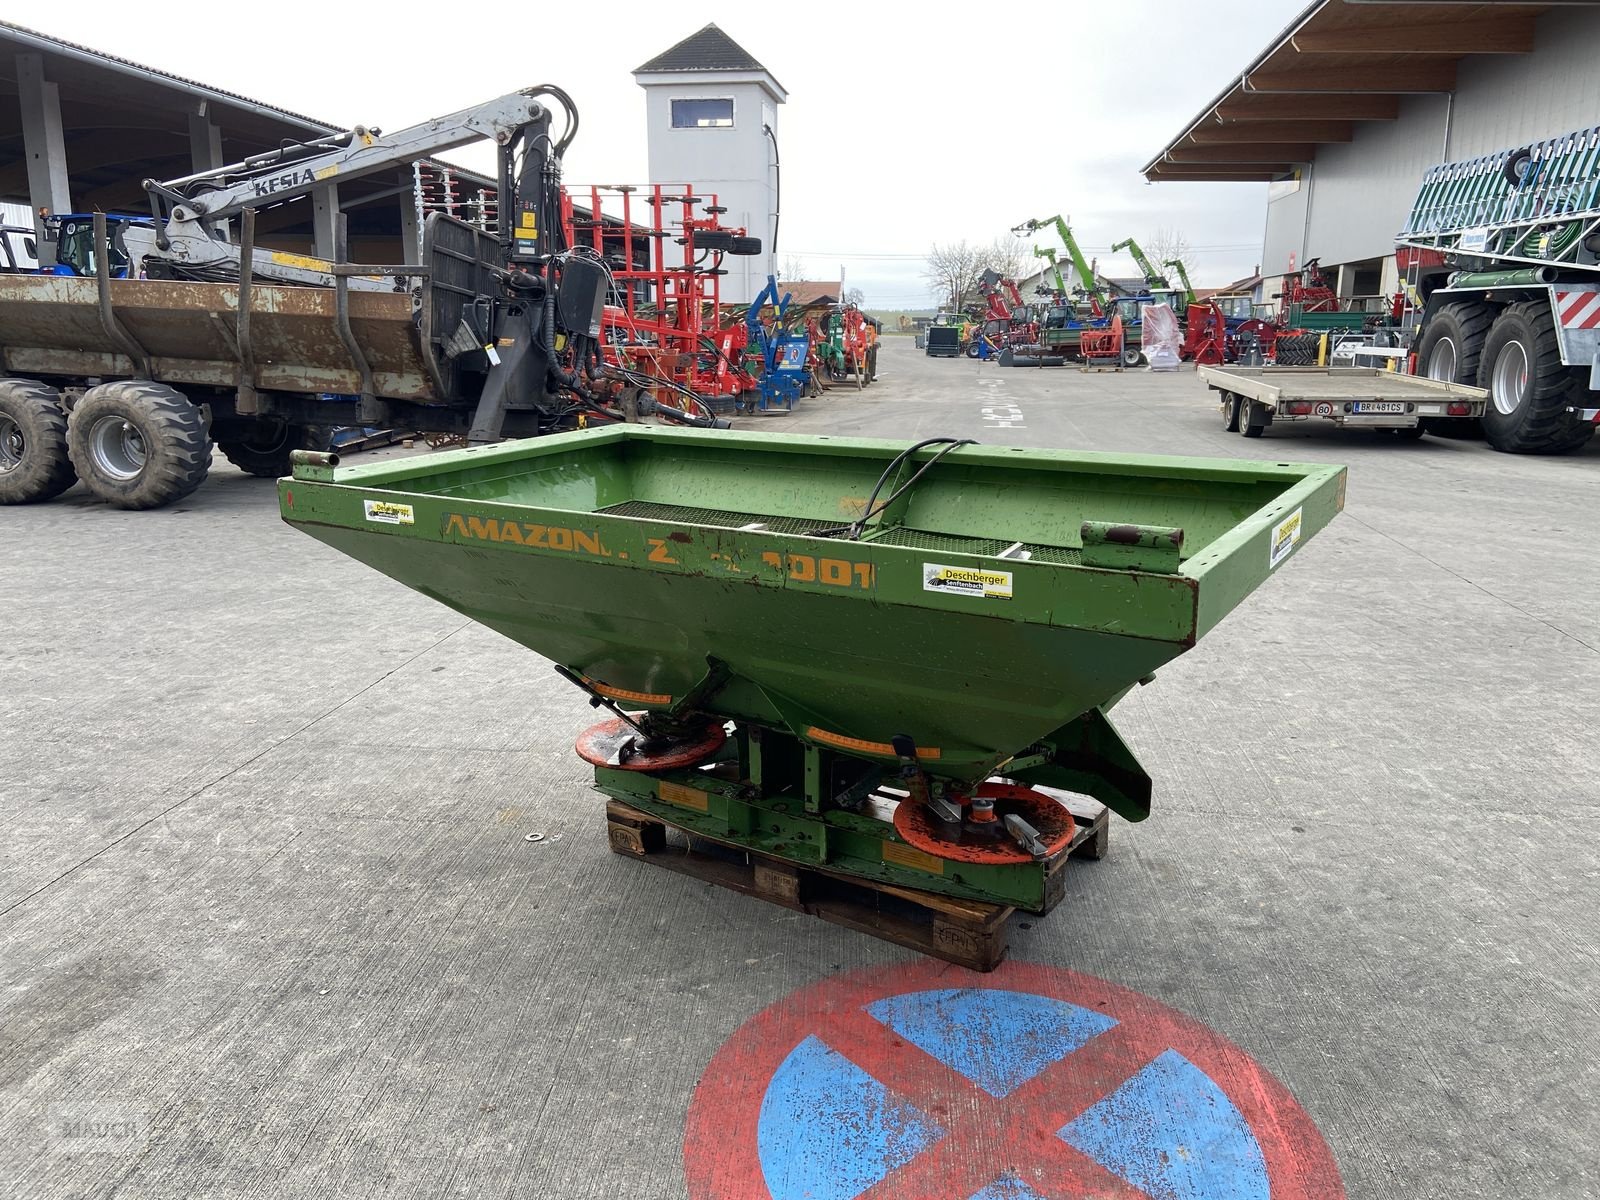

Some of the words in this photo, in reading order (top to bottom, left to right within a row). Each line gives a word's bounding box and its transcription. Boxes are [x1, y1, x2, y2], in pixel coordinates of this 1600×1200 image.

[1361, 403, 1371, 411] BR
[1376, 403, 1401, 412] 481CS
[446, 513, 628, 560] AMAZON
[945, 569, 1005, 586] Deschberger
[946, 579, 983, 590] Senftenbach
